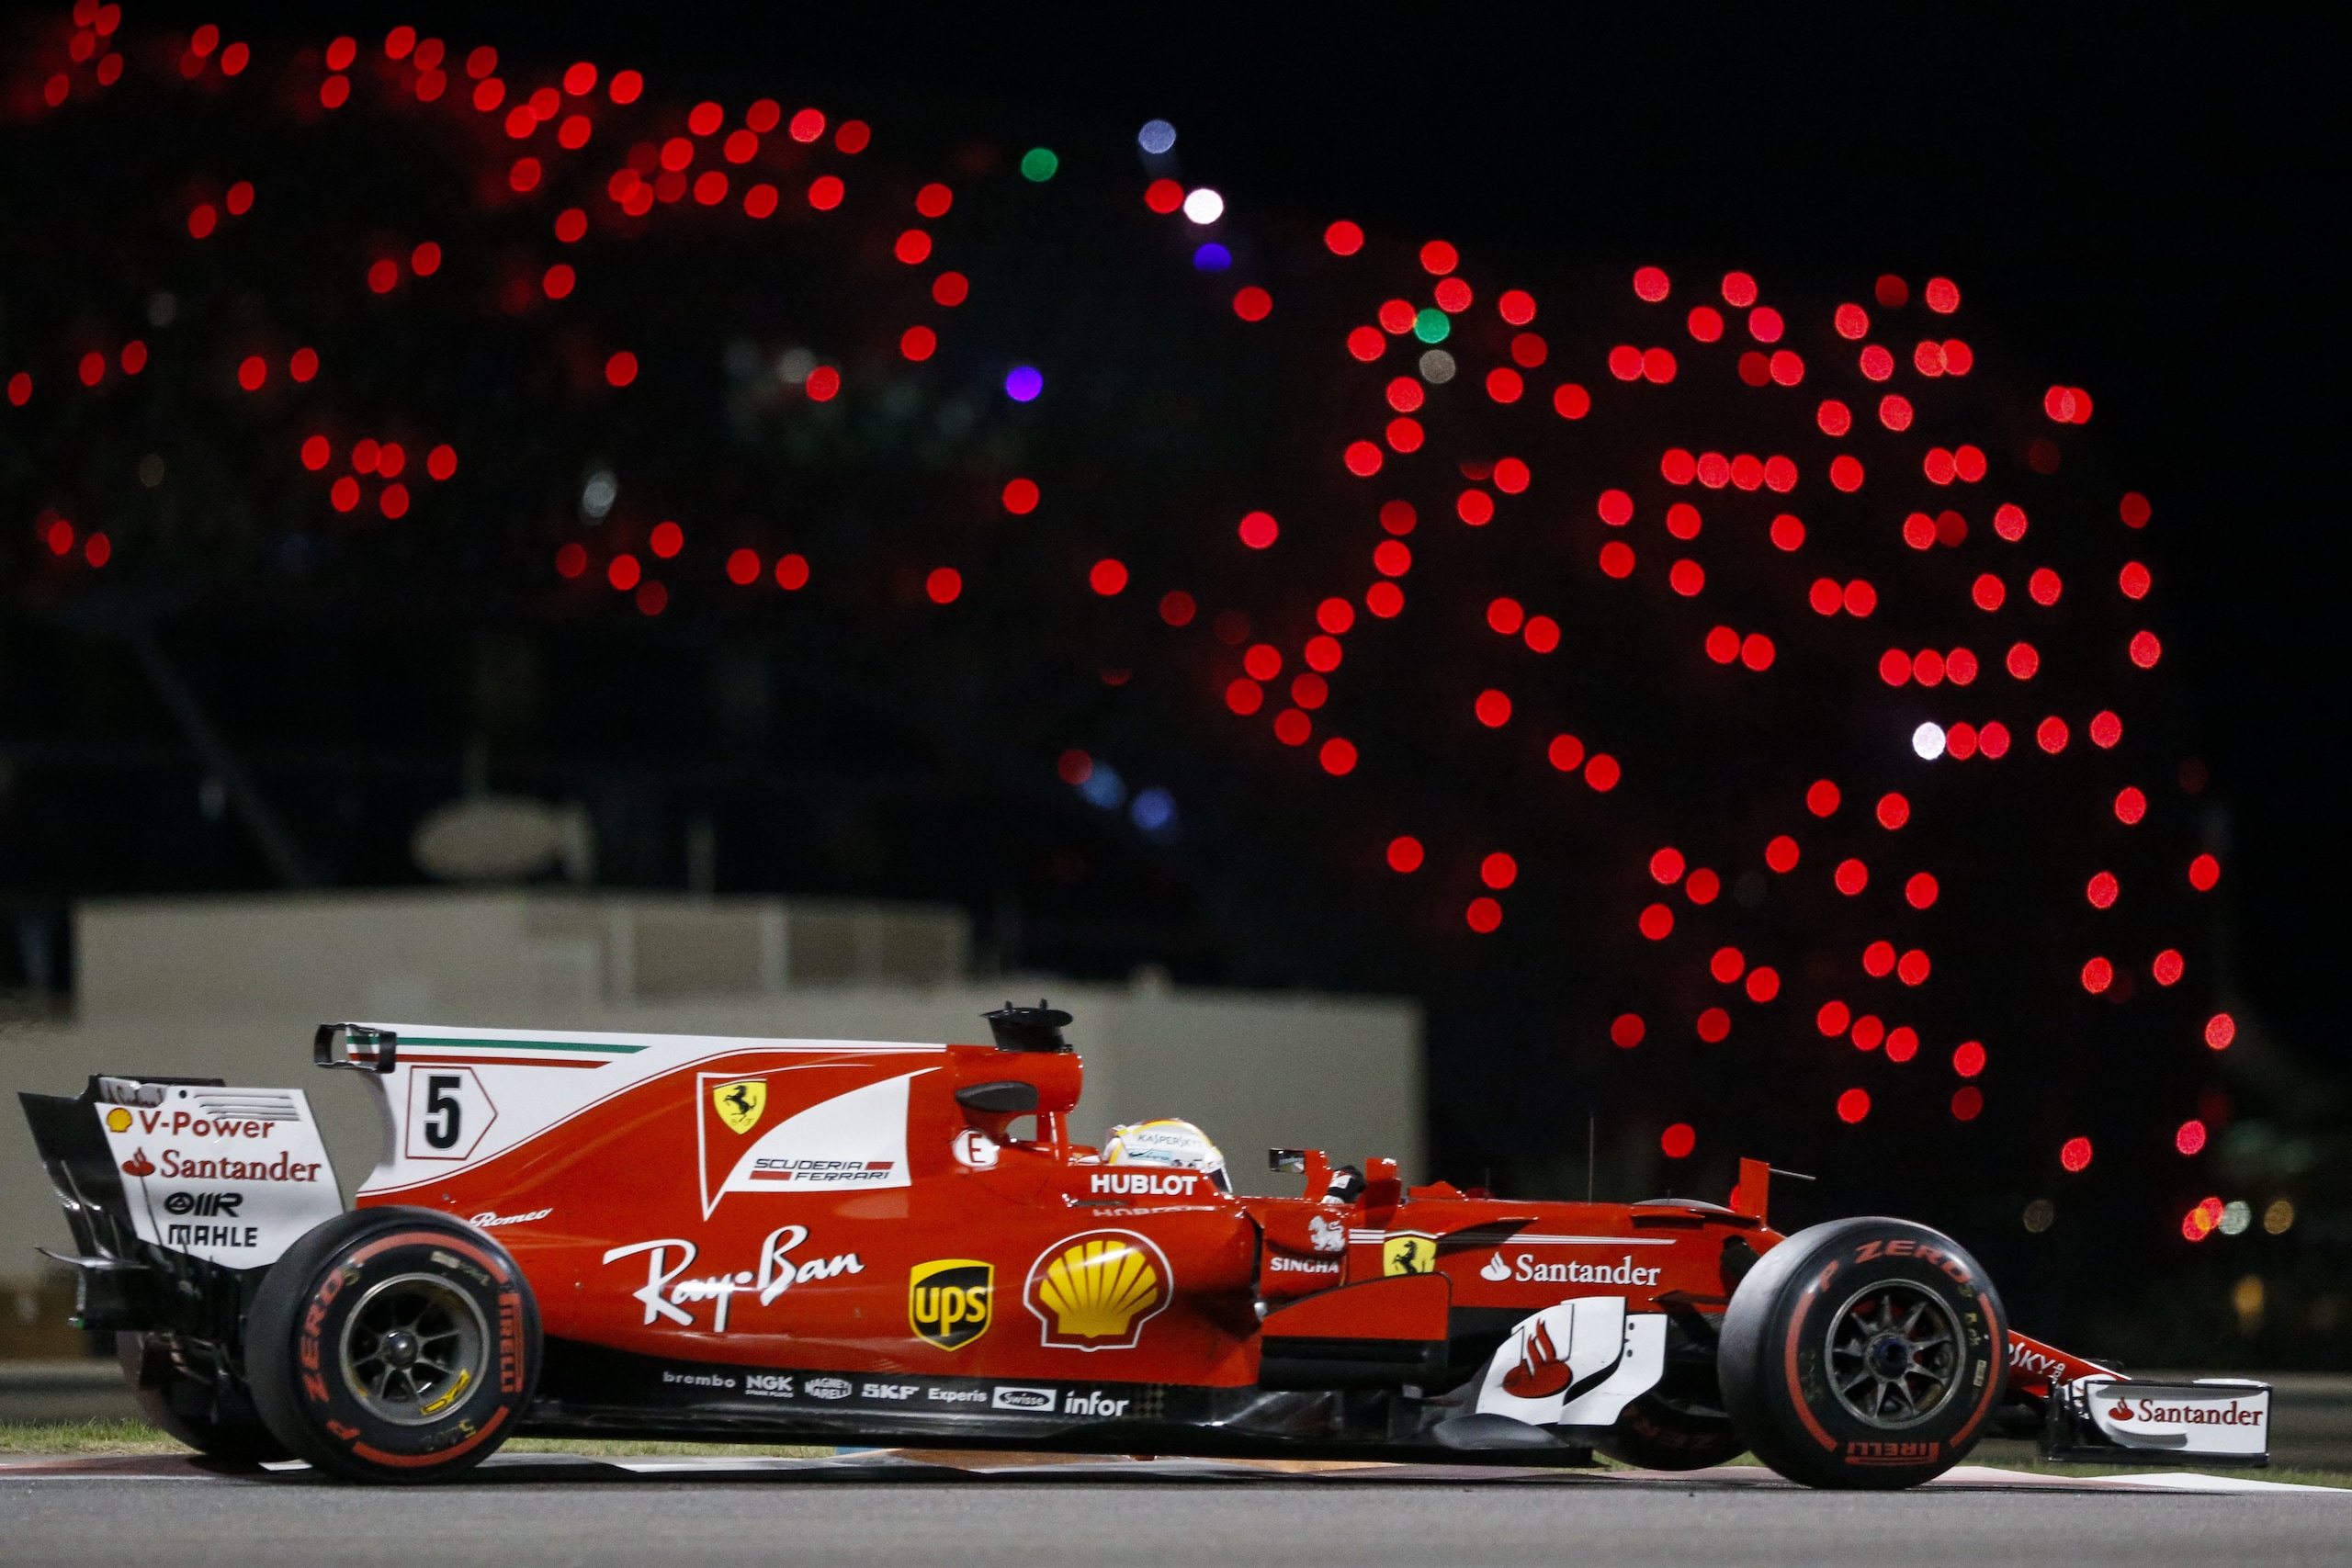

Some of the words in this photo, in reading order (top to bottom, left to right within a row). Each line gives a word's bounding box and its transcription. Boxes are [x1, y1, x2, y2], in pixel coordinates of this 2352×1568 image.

[139, 1110, 275, 1138] V-Power
[425, 1075, 462, 1150] 5
[967, 1134, 986, 1164] E
[161, 1149, 322, 1182] Santander
[754, 1158, 863, 1170] SCUDERIA
[795, 1171, 889, 1182] FERRARI
[1091, 1173, 1198, 1196] HUBLOT
[469, 1207, 553, 1228] Romeo
[168, 1224, 258, 1247] MAHLE
[1270, 1257, 1340, 1274] SINGHA
[1516, 1253, 1662, 1286] Santander
[1853, 1240, 1973, 1284] ZERO
[300, 1269, 346, 1403] ZERO
[499, 1292, 525, 1393] PIRELLI
[662, 1371, 737, 1388] brembo
[746, 1375, 794, 1392] NGK
[861, 1383, 920, 1400] SKF
[928, 1388, 988, 1404] Experis
[1002, 1392, 1046, 1406] Swisse
[1064, 1390, 1130, 1416] infor
[2138, 1398, 2264, 1427] Santander
[1845, 1441, 1940, 1465] PIRELLI
